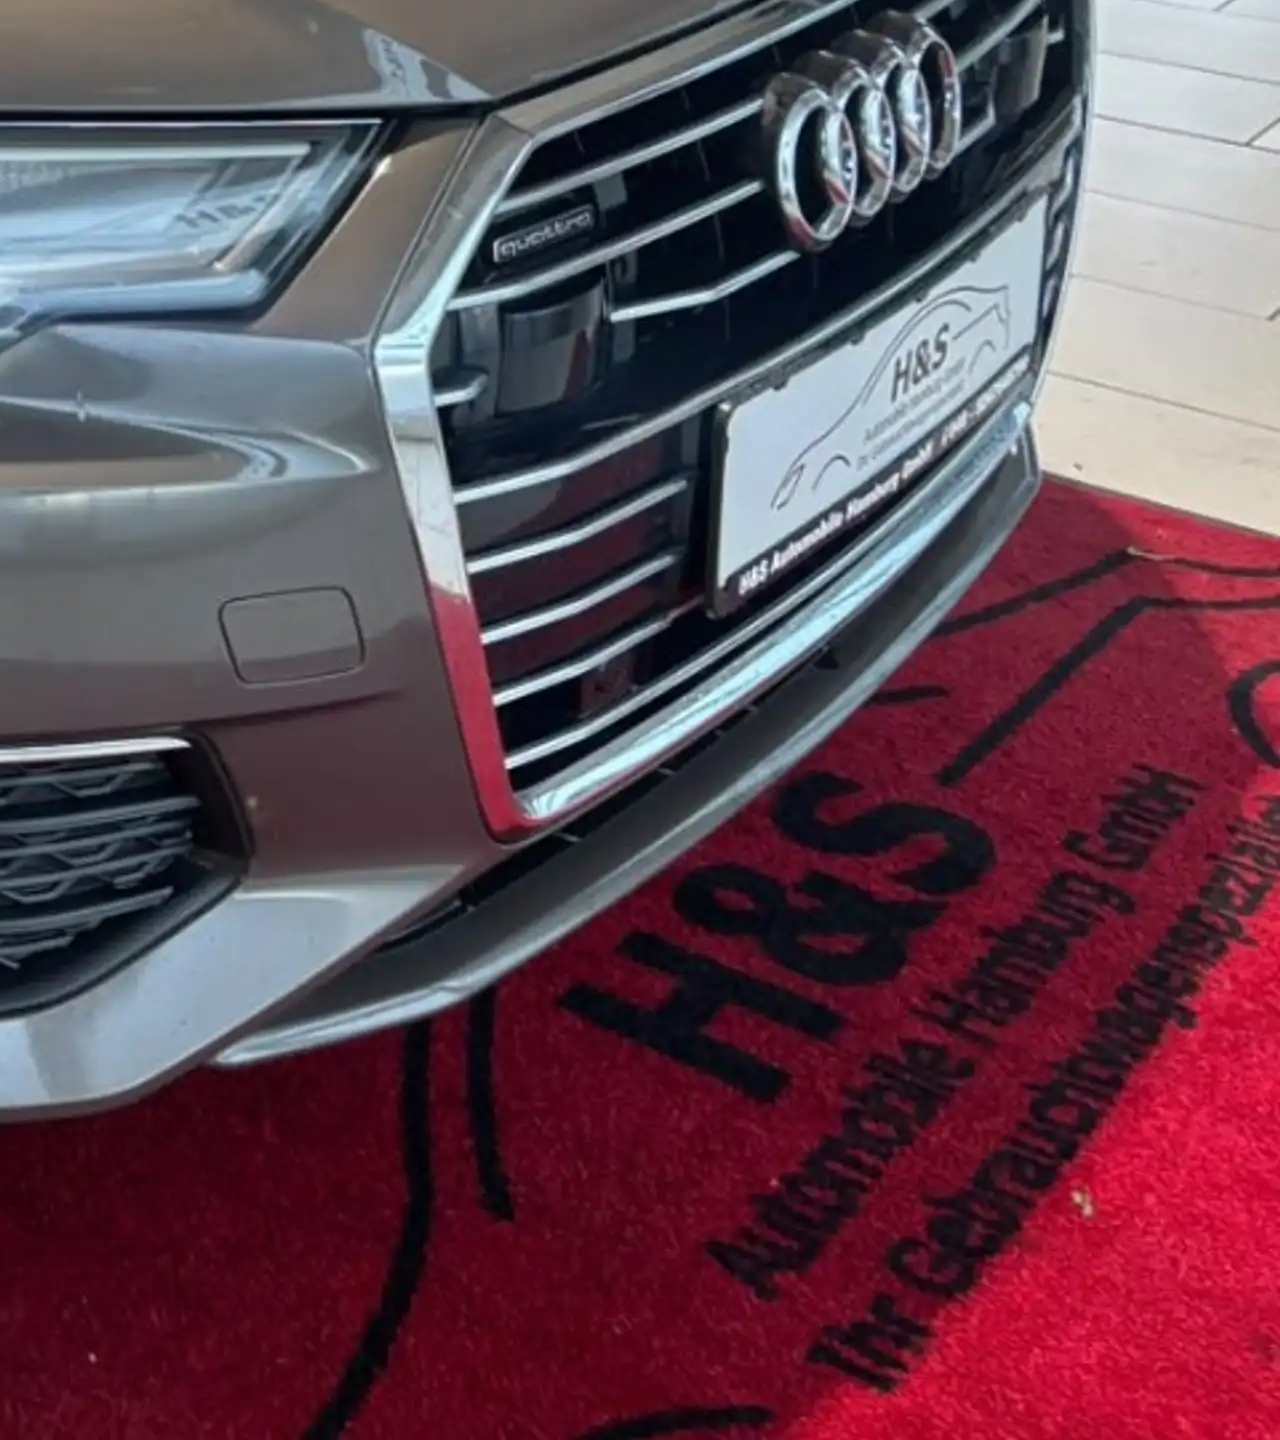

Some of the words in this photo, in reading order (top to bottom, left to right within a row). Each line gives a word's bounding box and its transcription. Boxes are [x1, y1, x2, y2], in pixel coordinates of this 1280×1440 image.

[500, 211, 590, 257] quattro
[890, 322, 950, 403] H&S
[556, 771, 999, 1105] H&S
[706, 1038, 976, 1304] Automobile
[909, 869, 1136, 1048] Hamburg
[1062, 762, 1209, 873] GmbH
[806, 1292, 936, 1397] Ihr
